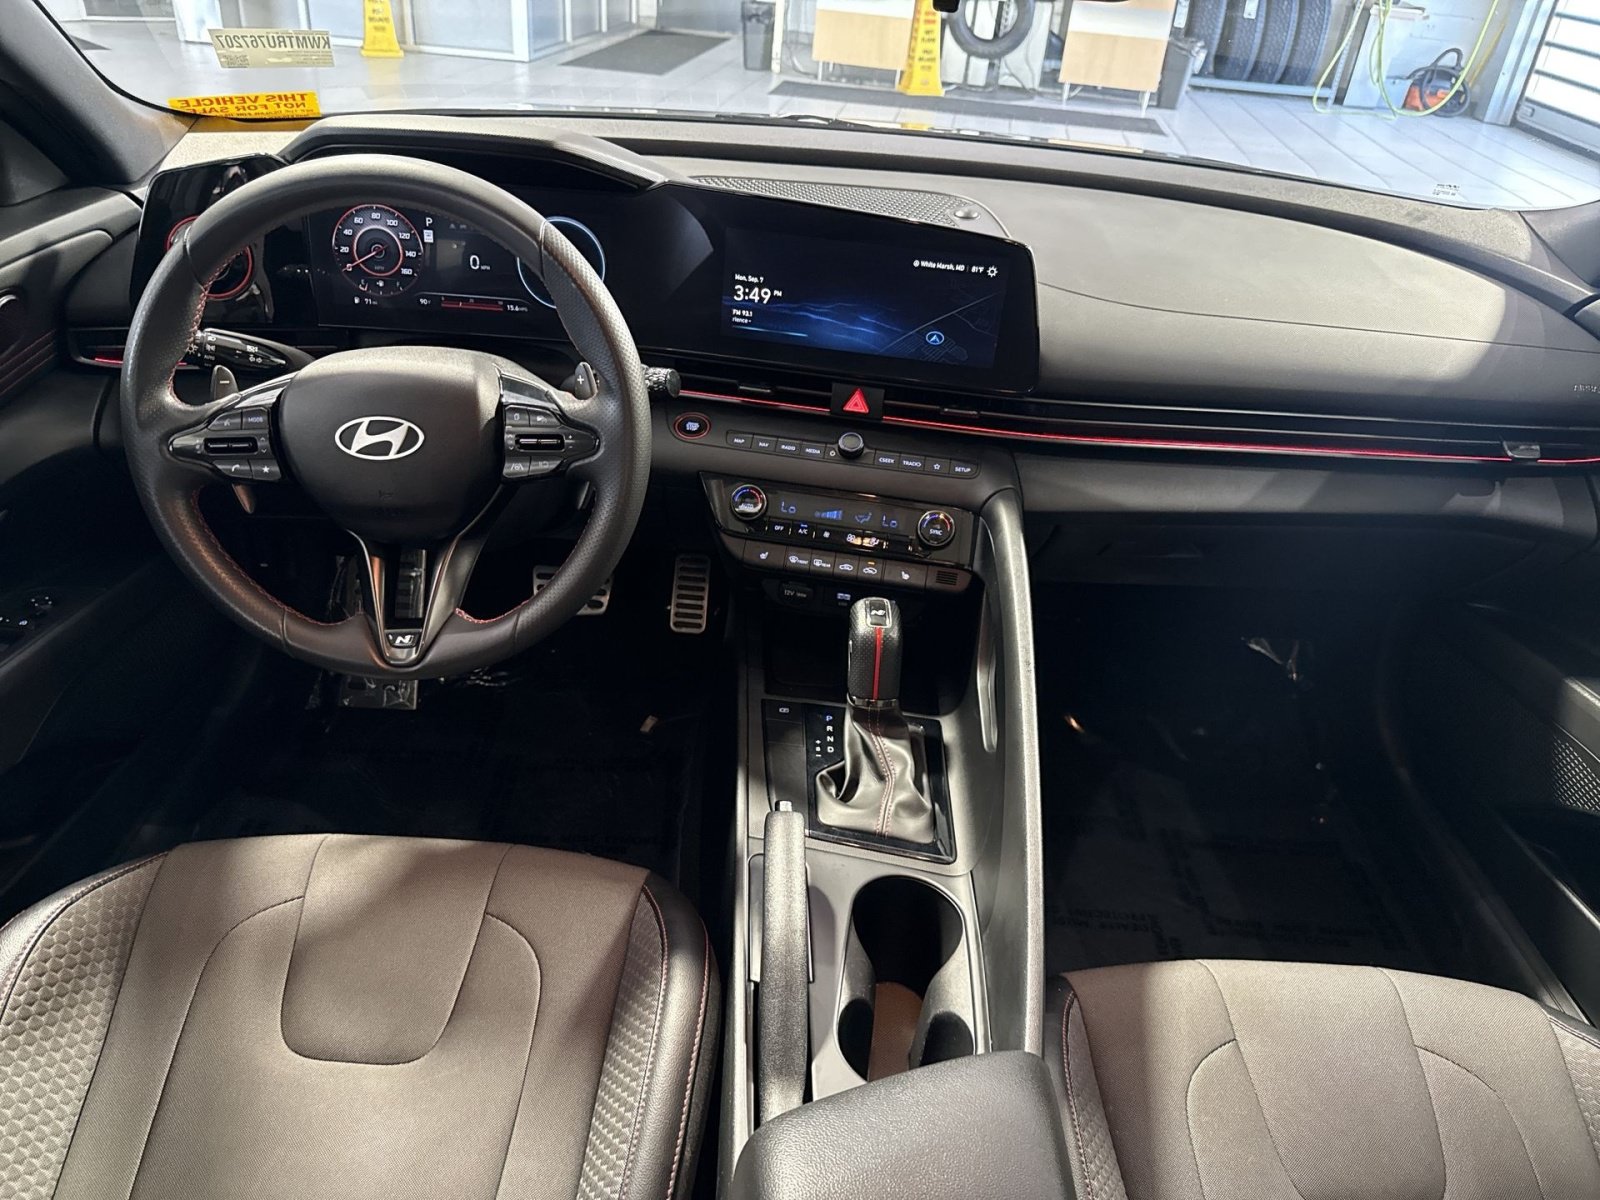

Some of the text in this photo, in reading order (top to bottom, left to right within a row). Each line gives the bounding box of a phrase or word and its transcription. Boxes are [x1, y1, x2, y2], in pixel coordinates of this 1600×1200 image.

[425, 217, 433, 227] P
[469, 255, 480, 270] 0
[920, 260, 936, 268] White
[955, 264, 966, 272] MD
[401, 267, 413, 275] 160
[733, 284, 782, 304] 3:49 PM
[780, 501, 797, 514] Lo
[881, 514, 898, 528] Lo
